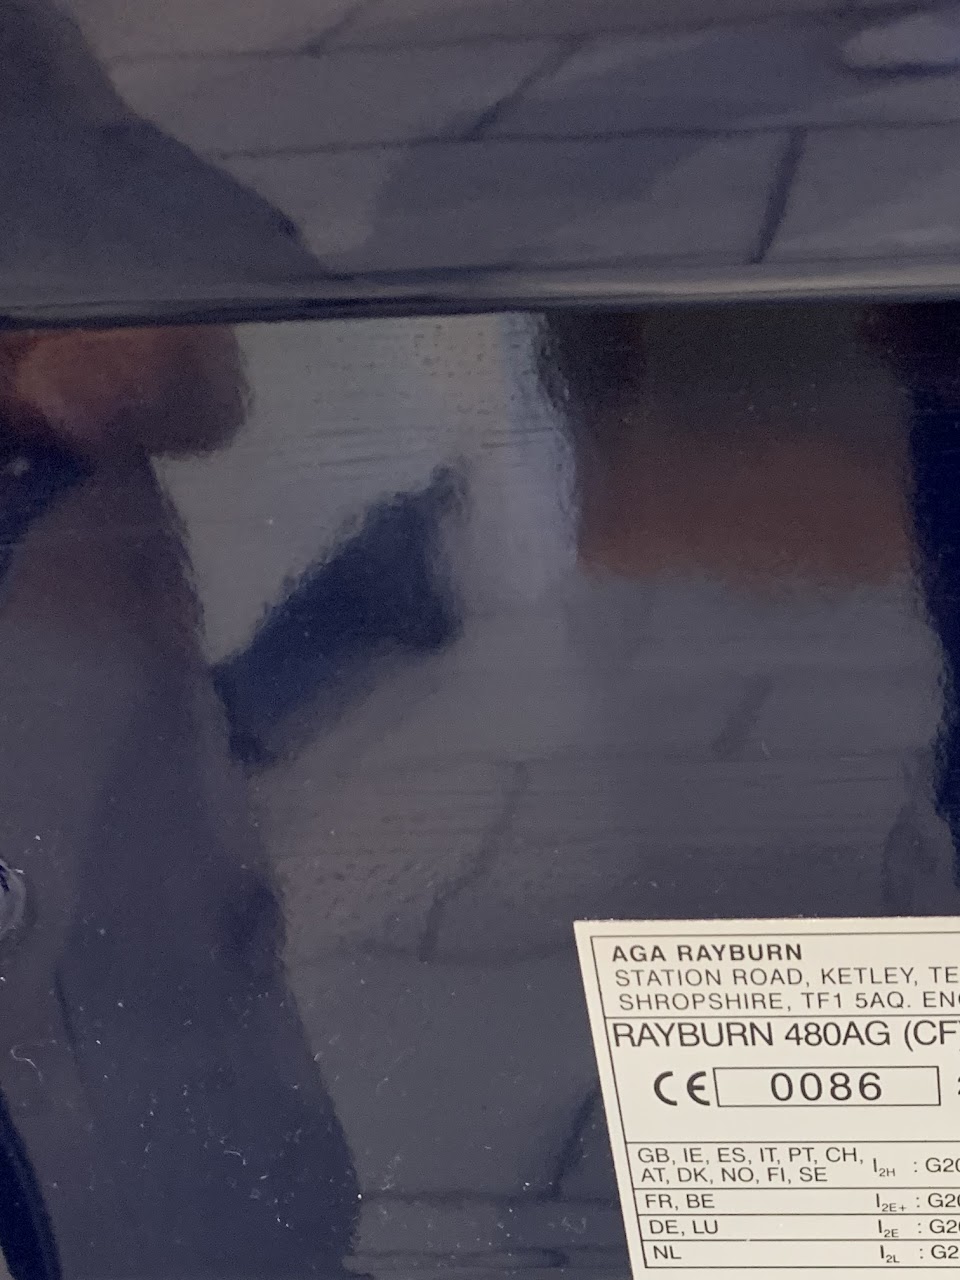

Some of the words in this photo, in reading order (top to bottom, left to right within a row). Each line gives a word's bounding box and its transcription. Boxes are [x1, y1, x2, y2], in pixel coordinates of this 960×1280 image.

[611, 944, 667, 963] AGA
[676, 943, 803, 962] RAYBURN
[615, 968, 722, 987] STATION
[732, 967, 810, 988] ROAD,
[820, 966, 918, 987] KETLEY,
[618, 992, 791, 1012] SHROPSHIRE,
[803, 991, 842, 1010] TF1
[855, 990, 911, 1009] 5AQ.
[612, 1020, 773, 1048] RAYBURN
[783, 1019, 892, 1048] 480AG
[769, 1071, 884, 1102] 0086
[637, 1147, 676, 1166] GB,
[683, 1147, 710, 1166] IE,
[717, 1147, 752, 1165] ES,
[759, 1147, 781, 1165] IT,
[788, 1146, 818, 1165] PT,
[825, 1146, 864, 1165] CH,
[641, 1167, 670, 1185] AT,
[677, 1166, 714, 1185] DK,
[721, 1166, 760, 1185] NO,
[767, 1166, 792, 1185] FI,
[799, 1166, 828, 1183] SE
[644, 1193, 679, 1211] FR,
[685, 1193, 715, 1209] BE
[648, 1219, 685, 1237] DE,
[691, 1219, 719, 1235] LU
[652, 1244, 682, 1260] NL
